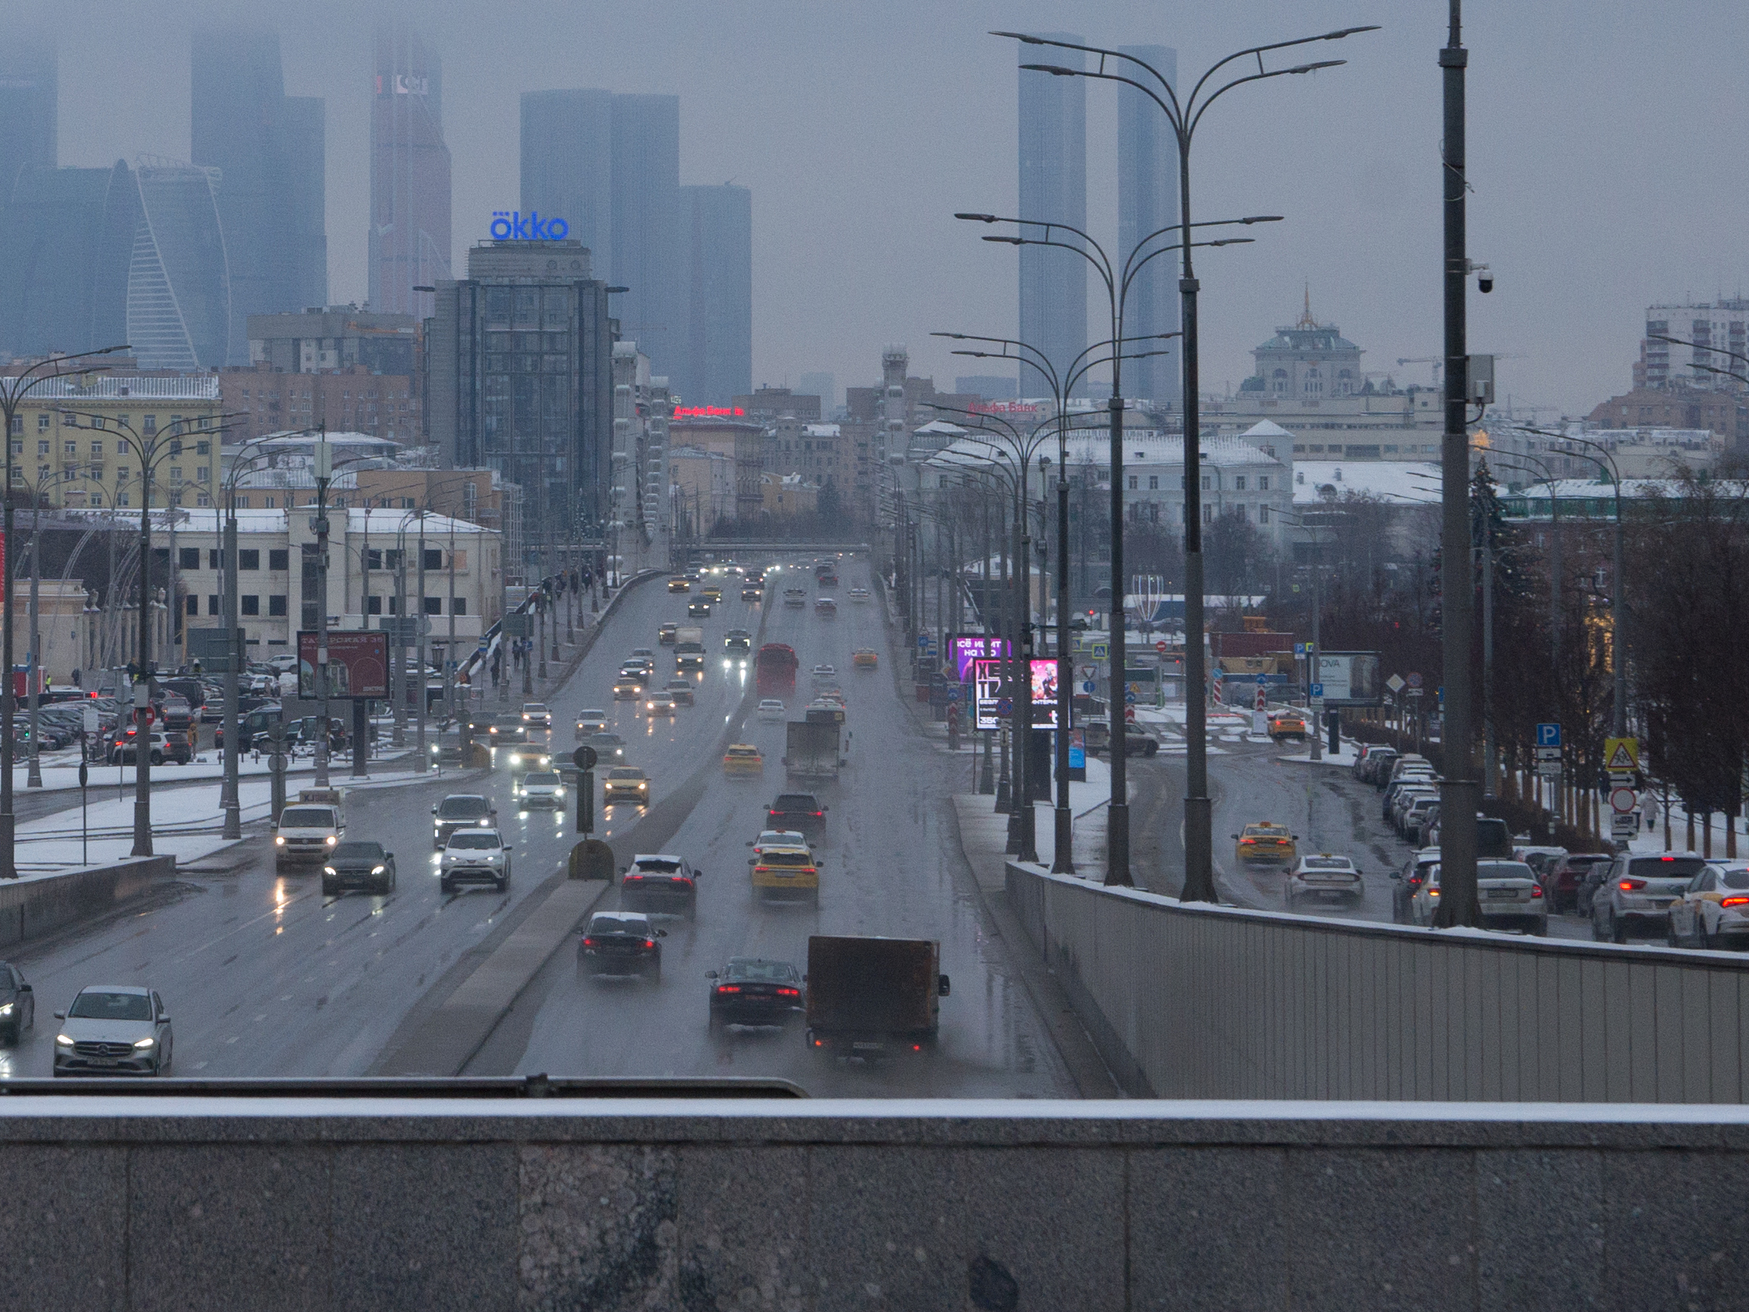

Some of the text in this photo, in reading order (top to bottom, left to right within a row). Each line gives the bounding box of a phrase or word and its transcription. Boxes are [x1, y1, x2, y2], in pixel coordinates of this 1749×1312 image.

[1008, 401, 1037, 413] Банк
[1312, 684, 1320, 695] P
[1543, 726, 1556, 744] P
